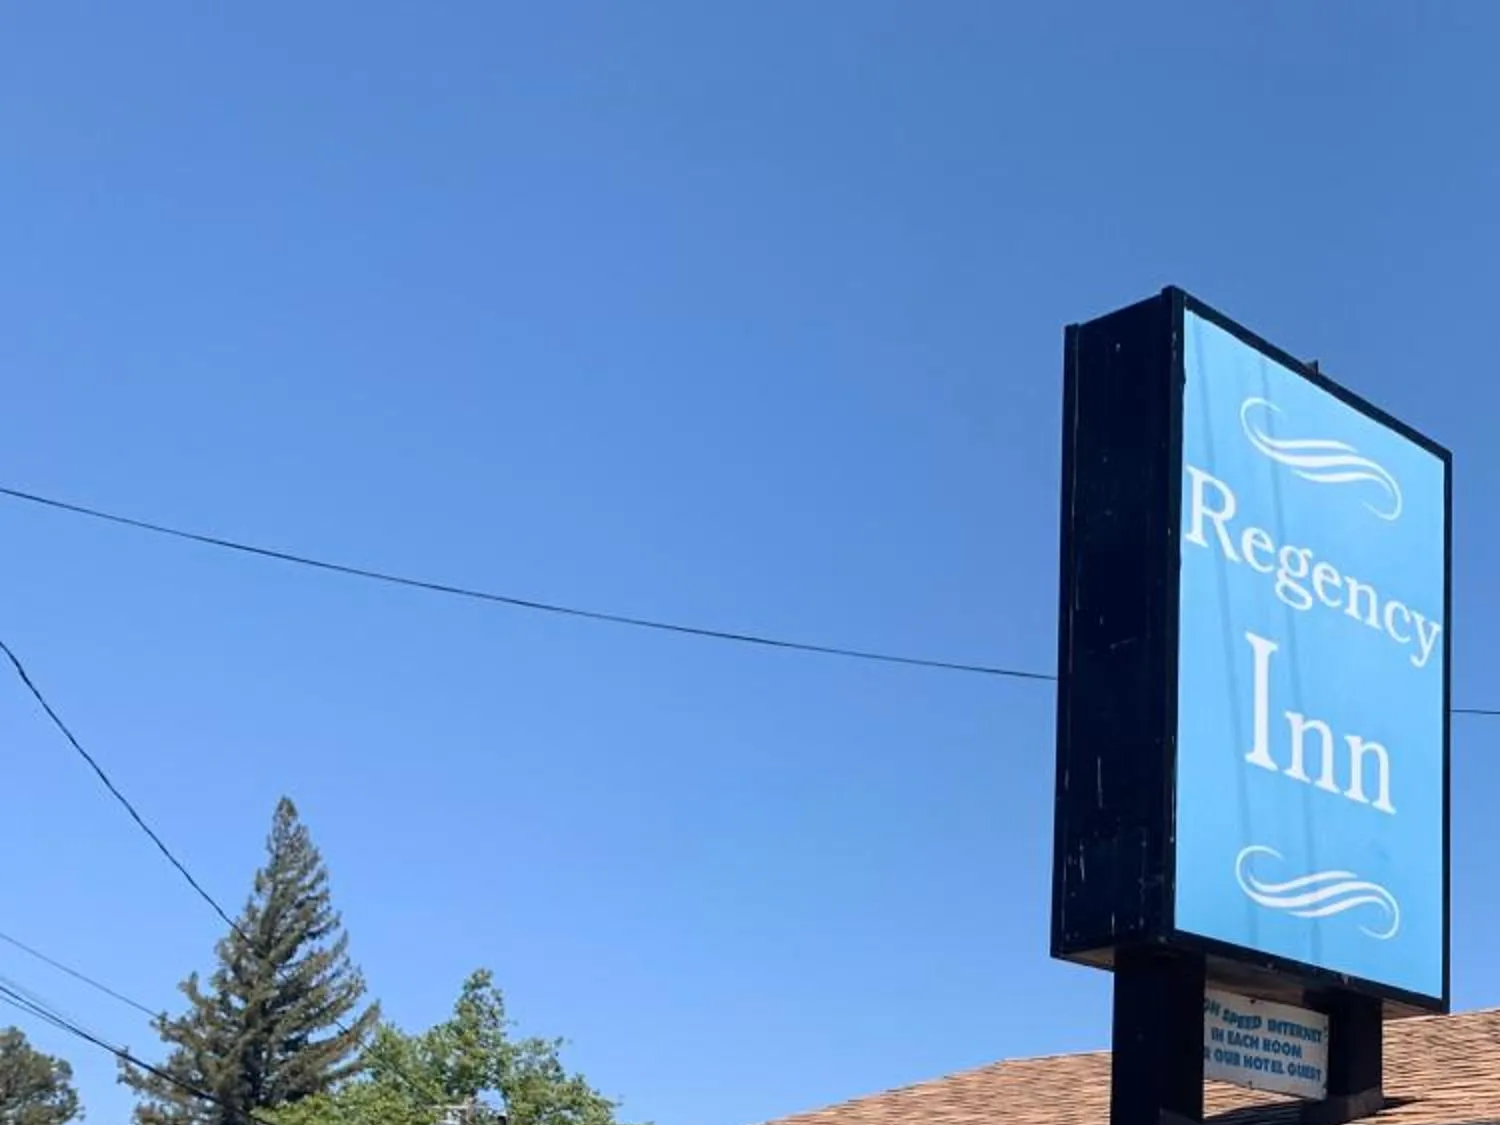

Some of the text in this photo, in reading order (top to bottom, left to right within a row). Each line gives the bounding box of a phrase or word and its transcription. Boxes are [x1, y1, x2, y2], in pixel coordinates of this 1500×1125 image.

[1184, 464, 1442, 668] Regency
[1244, 631, 1397, 815] Inn
[1210, 1027, 1302, 1059] IN EACH ROOM
[1222, 1008, 1262, 1030] SPEED
[1267, 1018, 1322, 1043] INTERNET
[1213, 1048, 1241, 1066] OUR
[1287, 1062, 1322, 1081] GUEST
